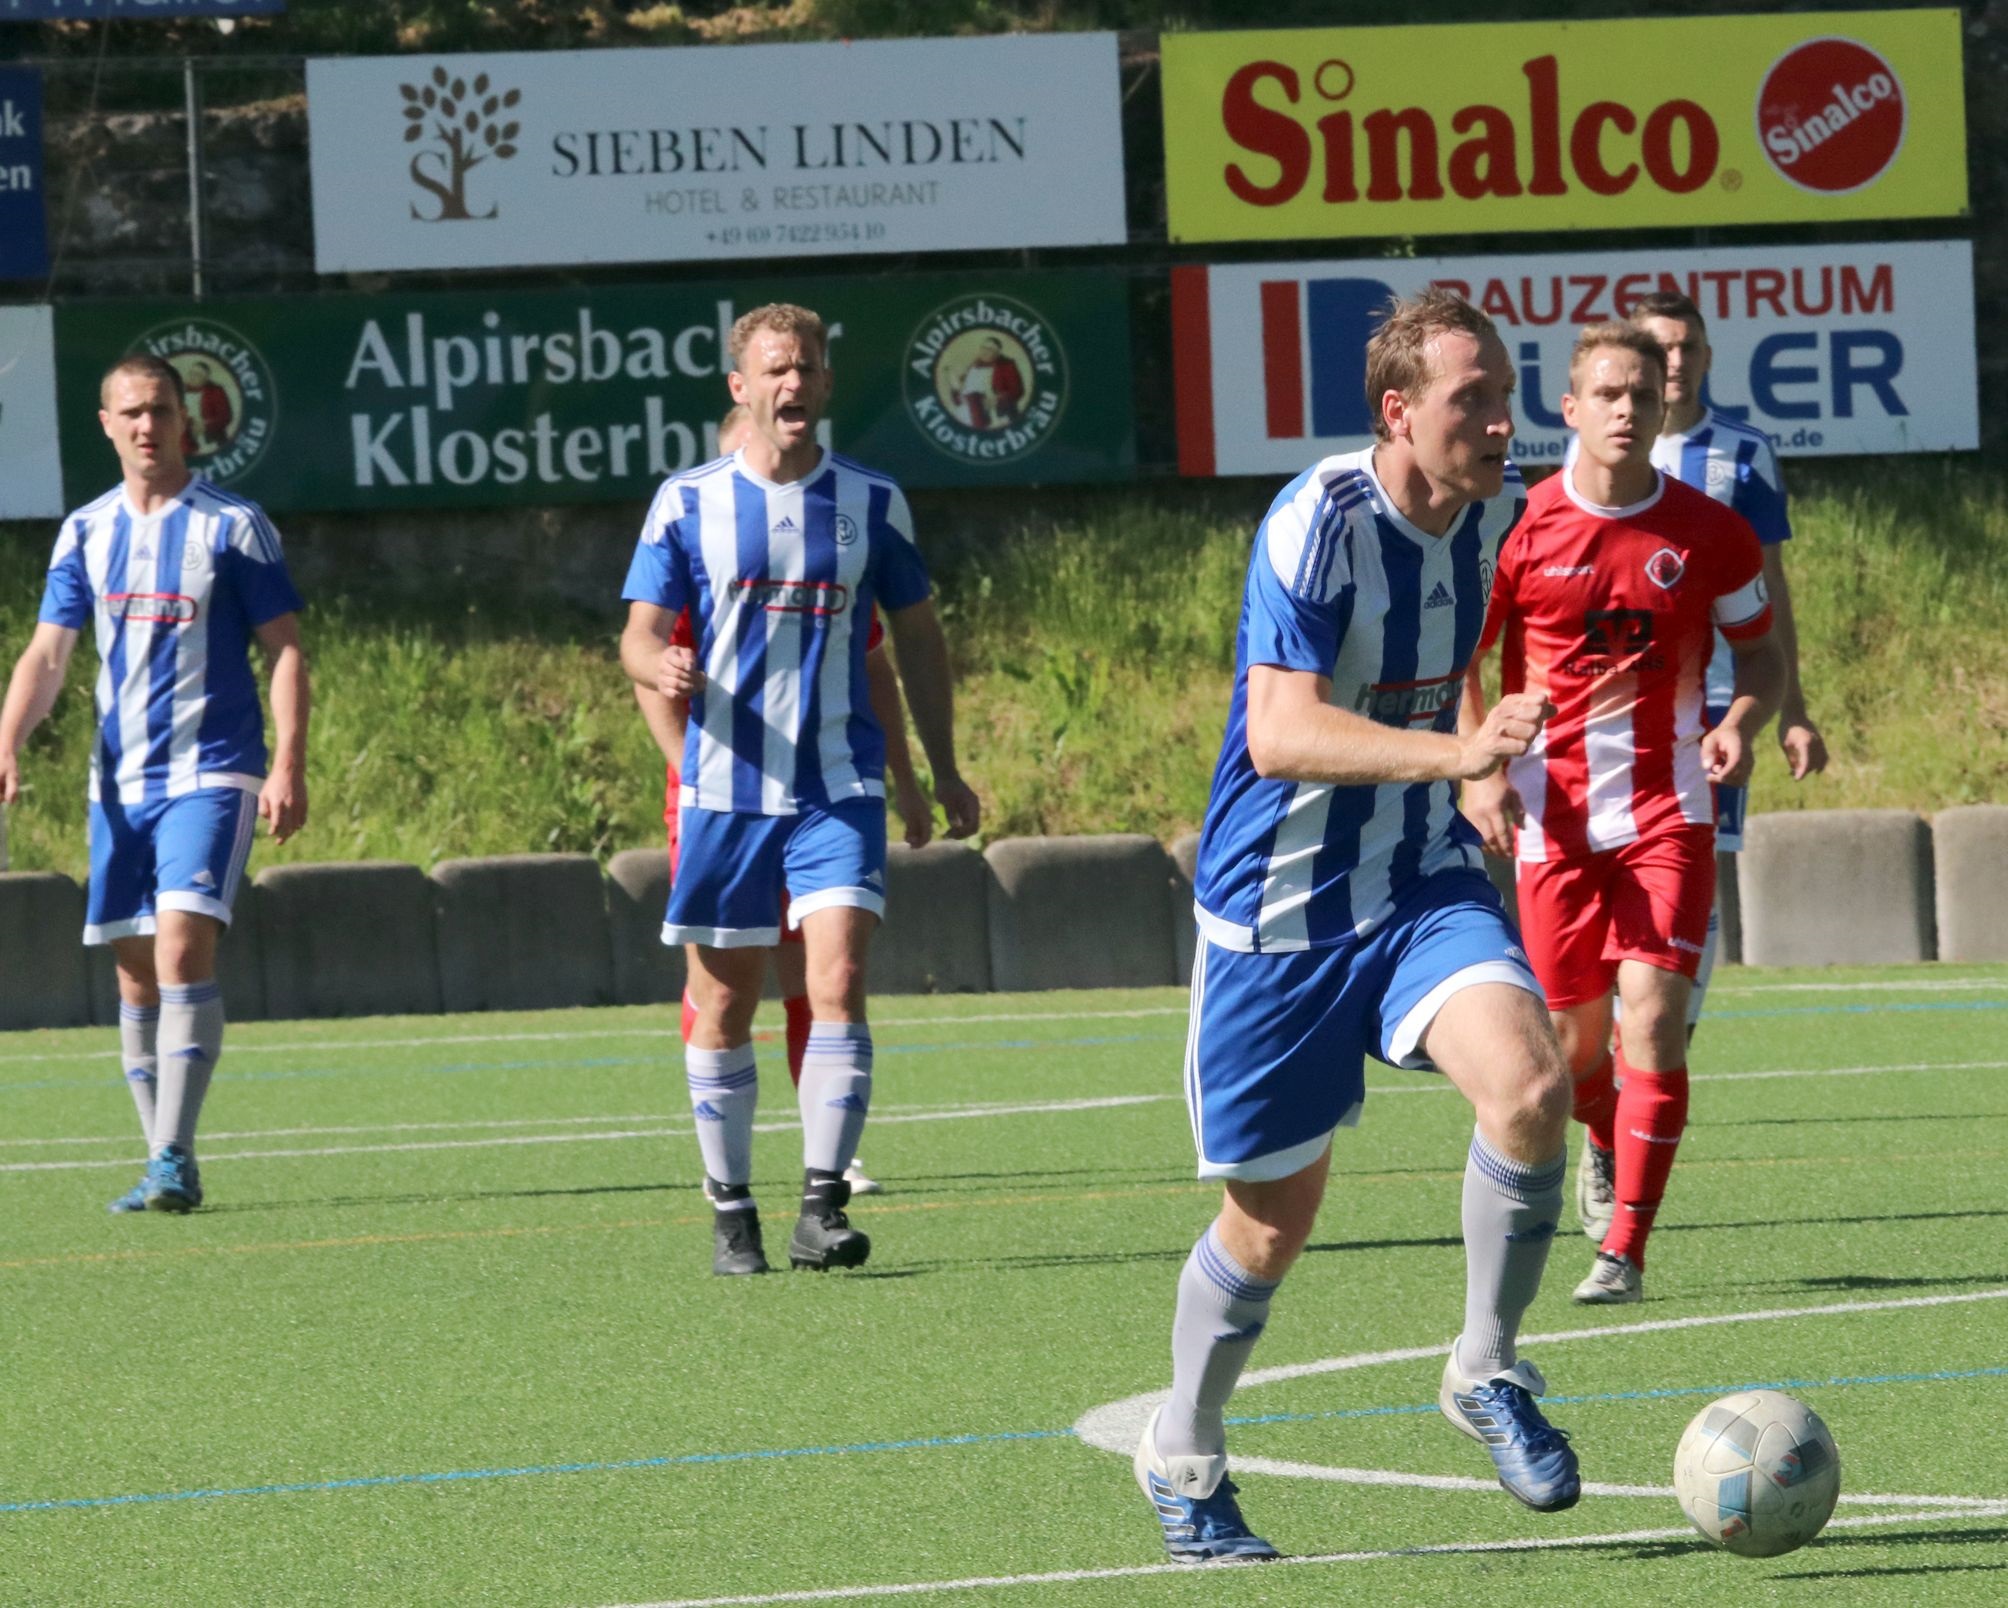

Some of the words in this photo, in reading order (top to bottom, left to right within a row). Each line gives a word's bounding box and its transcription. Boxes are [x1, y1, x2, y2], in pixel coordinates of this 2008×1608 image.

[551, 125, 768, 178] SIEBEN
[791, 117, 1028, 170] LINDEN
[1220, 54, 1720, 207] Sinalco
[1767, 73, 1892, 165] Sinalco
[645, 186, 728, 214] HOTEL
[741, 187, 759, 212] &
[773, 180, 940, 211] RESTAURANT
[145, 324, 264, 401] irsbacher
[911, 300, 1055, 379] Alpirsbacher
[914, 390, 1058, 458] Klosterbräu
